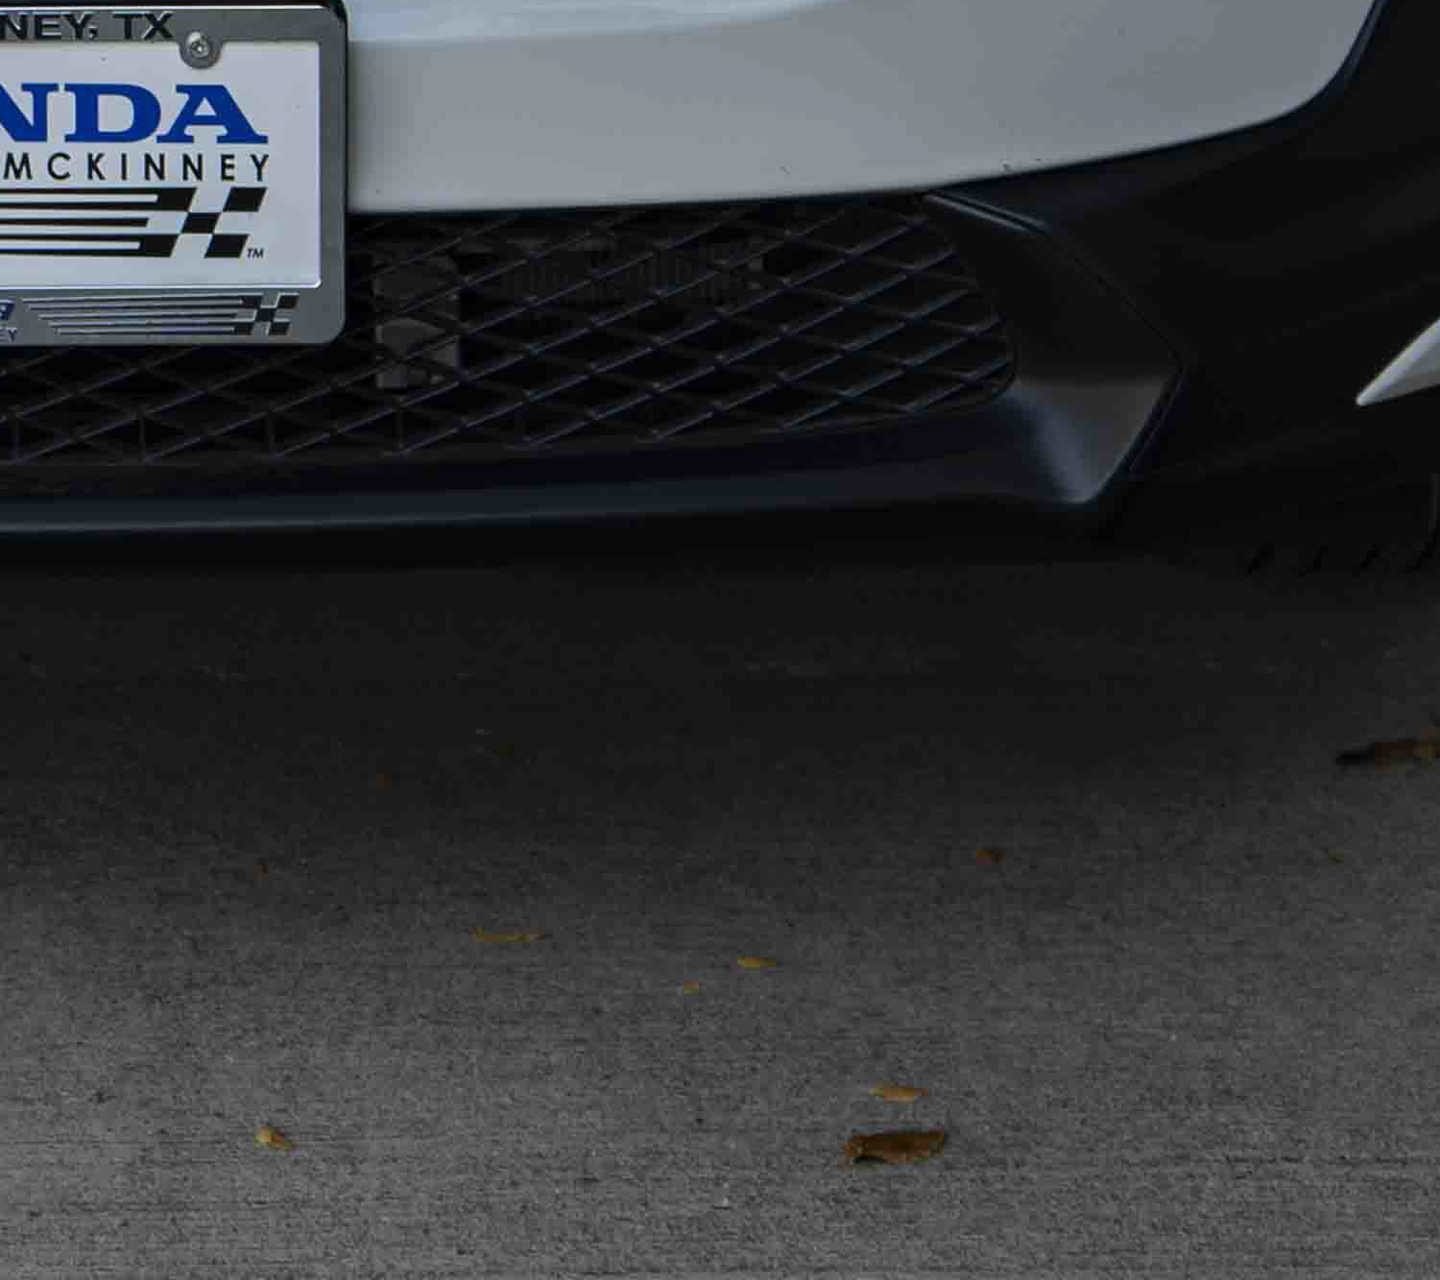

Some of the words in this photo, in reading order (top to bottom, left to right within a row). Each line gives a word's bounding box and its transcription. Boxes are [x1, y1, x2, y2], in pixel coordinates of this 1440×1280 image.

[114, 11, 174, 40] TX
[3, 152, 270, 182] MCKINNEY
[247, 248, 264, 259] TM
